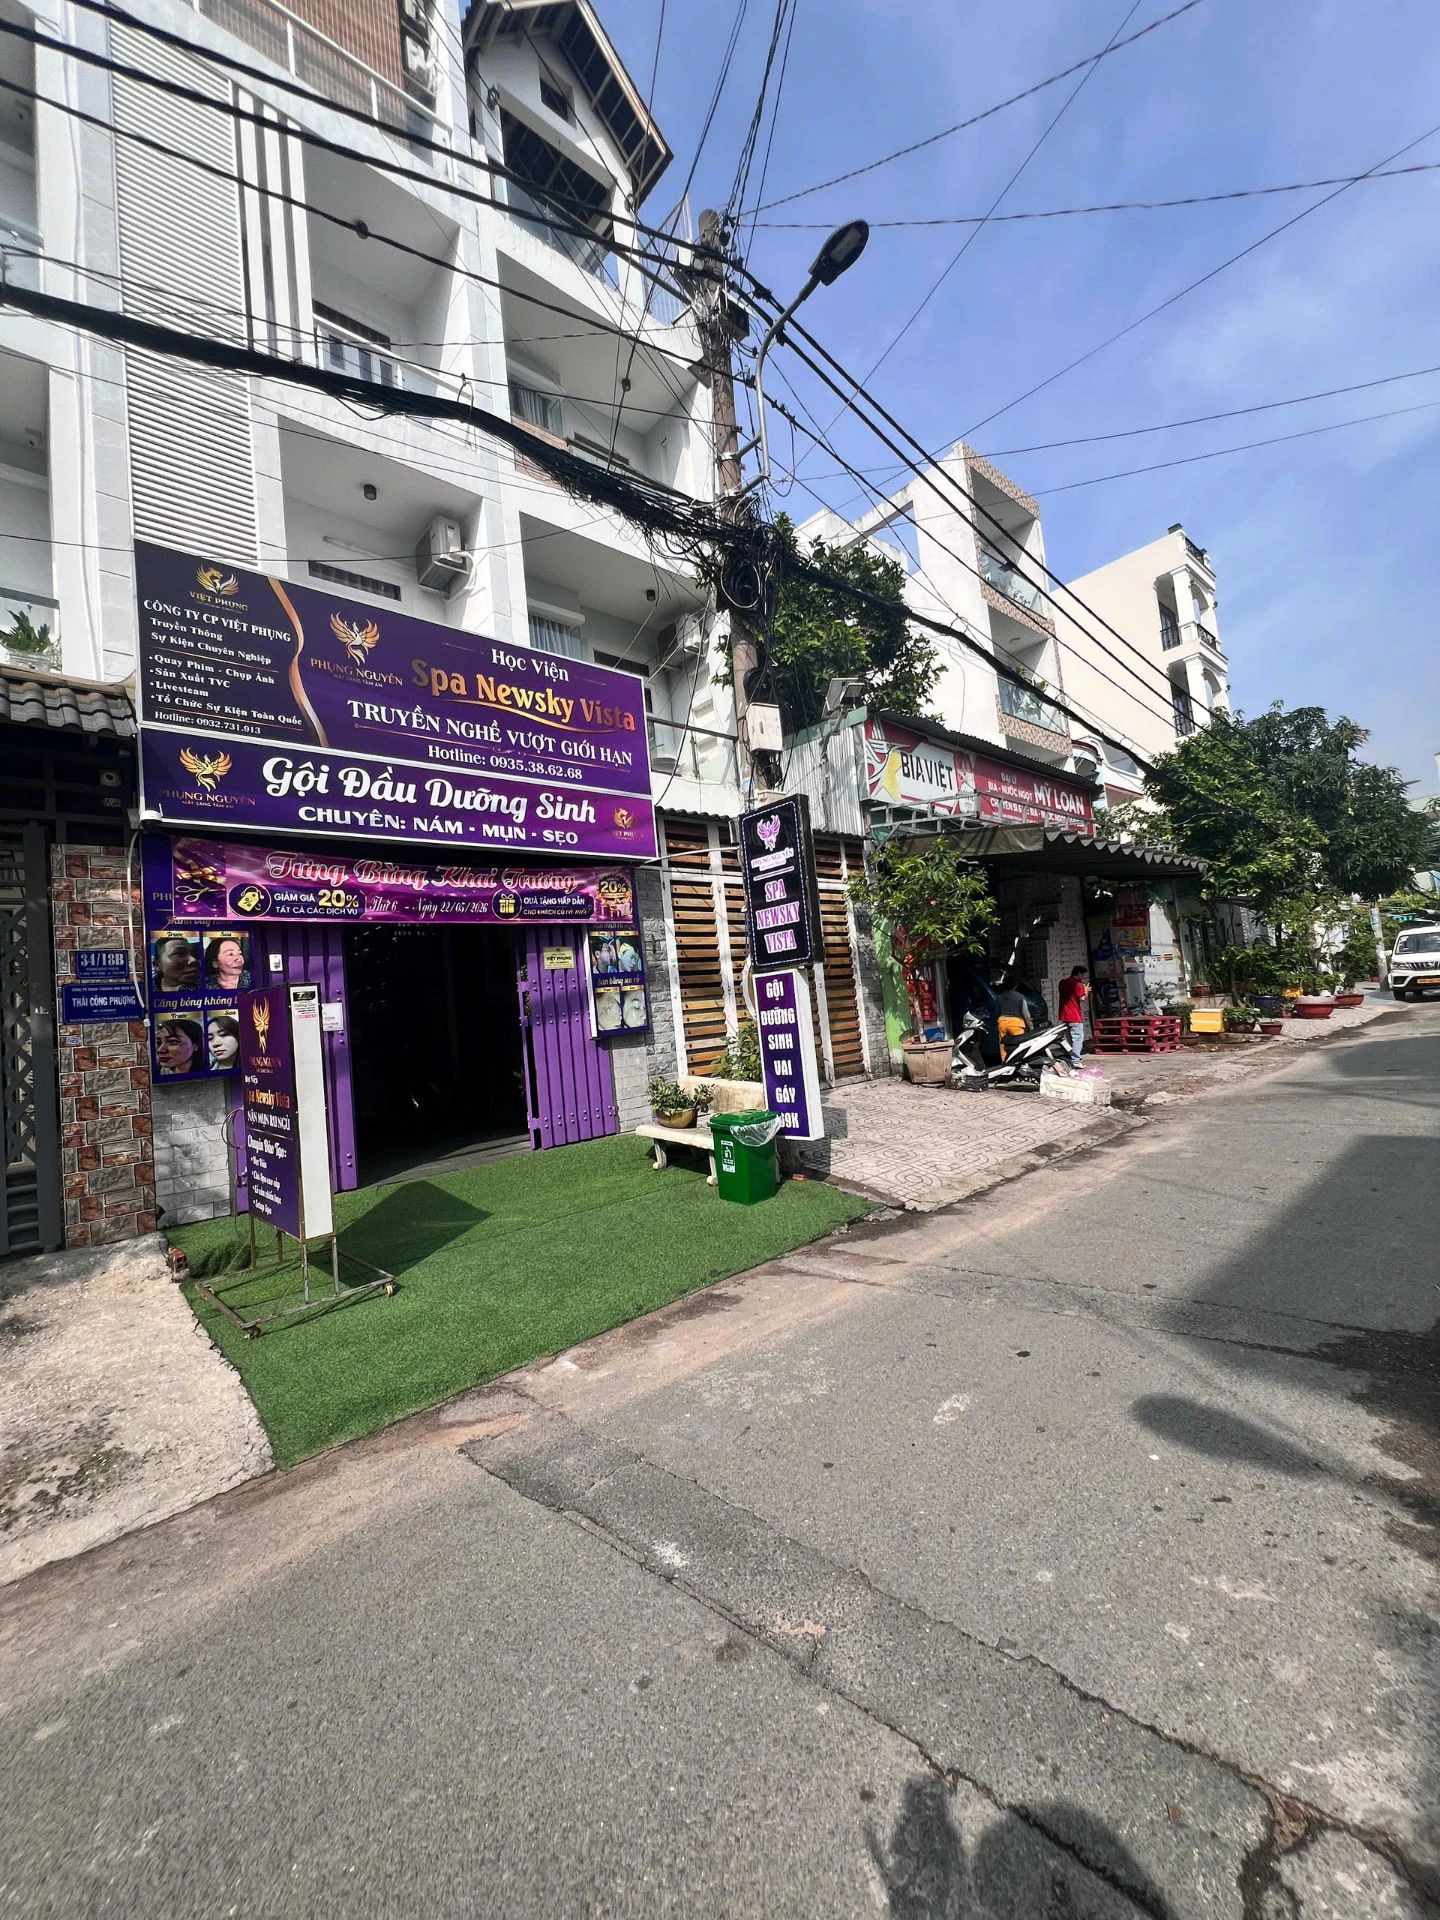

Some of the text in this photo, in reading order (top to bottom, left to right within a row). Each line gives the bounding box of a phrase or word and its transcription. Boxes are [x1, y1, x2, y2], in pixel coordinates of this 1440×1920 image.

[143, 599, 182, 616] CÔNG
[184, 608, 200, 620] TY
[202, 613, 219, 625] CP
[220, 618, 248, 633] VIỆT
[251, 625, 291, 642] PHỤNG
[150, 617, 223, 641] Truyền Thông
[151, 631, 272, 665] Sự Kiện Chuyên Nghiệp
[155, 655, 183, 667] Quay
[187, 661, 214, 672] Phim
[225, 669, 252, 681] Chụp
[255, 673, 275, 684] Ảnh
[311, 658, 352, 675] PHỤNG
[491, 649, 570, 682] Học Viện
[155, 667, 231, 688] Sản Xuất TVC
[156, 682, 209, 697] Livesteam
[411, 658, 636, 732] Spa Newsky Vista
[156, 693, 302, 725] Tổ Chức Sự Kiện Toàn Quốc
[155, 711, 261, 735] Hotline: 0932.731.913
[347, 699, 633, 766] TRUYỀN NGHỀ VƯỢT GIỚI HẠN
[428, 745, 583, 780] Hotline: 0935.38.62.68
[262, 756, 596, 824] Gội Đầu Dưỡng Sinh
[987, 781, 998, 792] BIA
[1001, 784, 1018, 797] NƯỚC
[1033, 782, 1052, 807] MỸ
[1054, 789, 1085, 816] LOAN
[299, 805, 406, 830] CHUYÊN:
[413, 816, 463, 835] NÁM
[483, 823, 526, 842] MỤN
[542, 829, 578, 846] SẸO
[266, 851, 577, 894] Tưng Bừng Khai Trương
[600, 881, 627, 893] 20%
[765, 880, 786, 901] SPA
[274, 889, 359, 908] GIẢM GIÁ 20%
[391, 900, 397, 912] 6
[440, 901, 489, 914] 22/05/2026
[523, 896, 538, 905] QUÀ
[540, 896, 557, 906] TẶNG
[276, 905, 358, 916] TẤT CẢ CÁC DỊCH VỤ
[756, 902, 800, 930] NEWSKY
[764, 930, 797, 953] VISTA
[81, 953, 124, 967] 34/18B
[72, 994, 136, 1007] THÁI CÔNG PHƯỢNG
[766, 979, 784, 1001] GỘI
[154, 998, 178, 1009] Căng
[180, 997, 203, 1009] bóng
[204, 994, 233, 1006] không
[761, 1007, 796, 1026] DƯỠNG
[768, 1034, 793, 1050] SINH
[774, 1060, 792, 1076] VAI
[776, 1084, 796, 1103] GÁY
